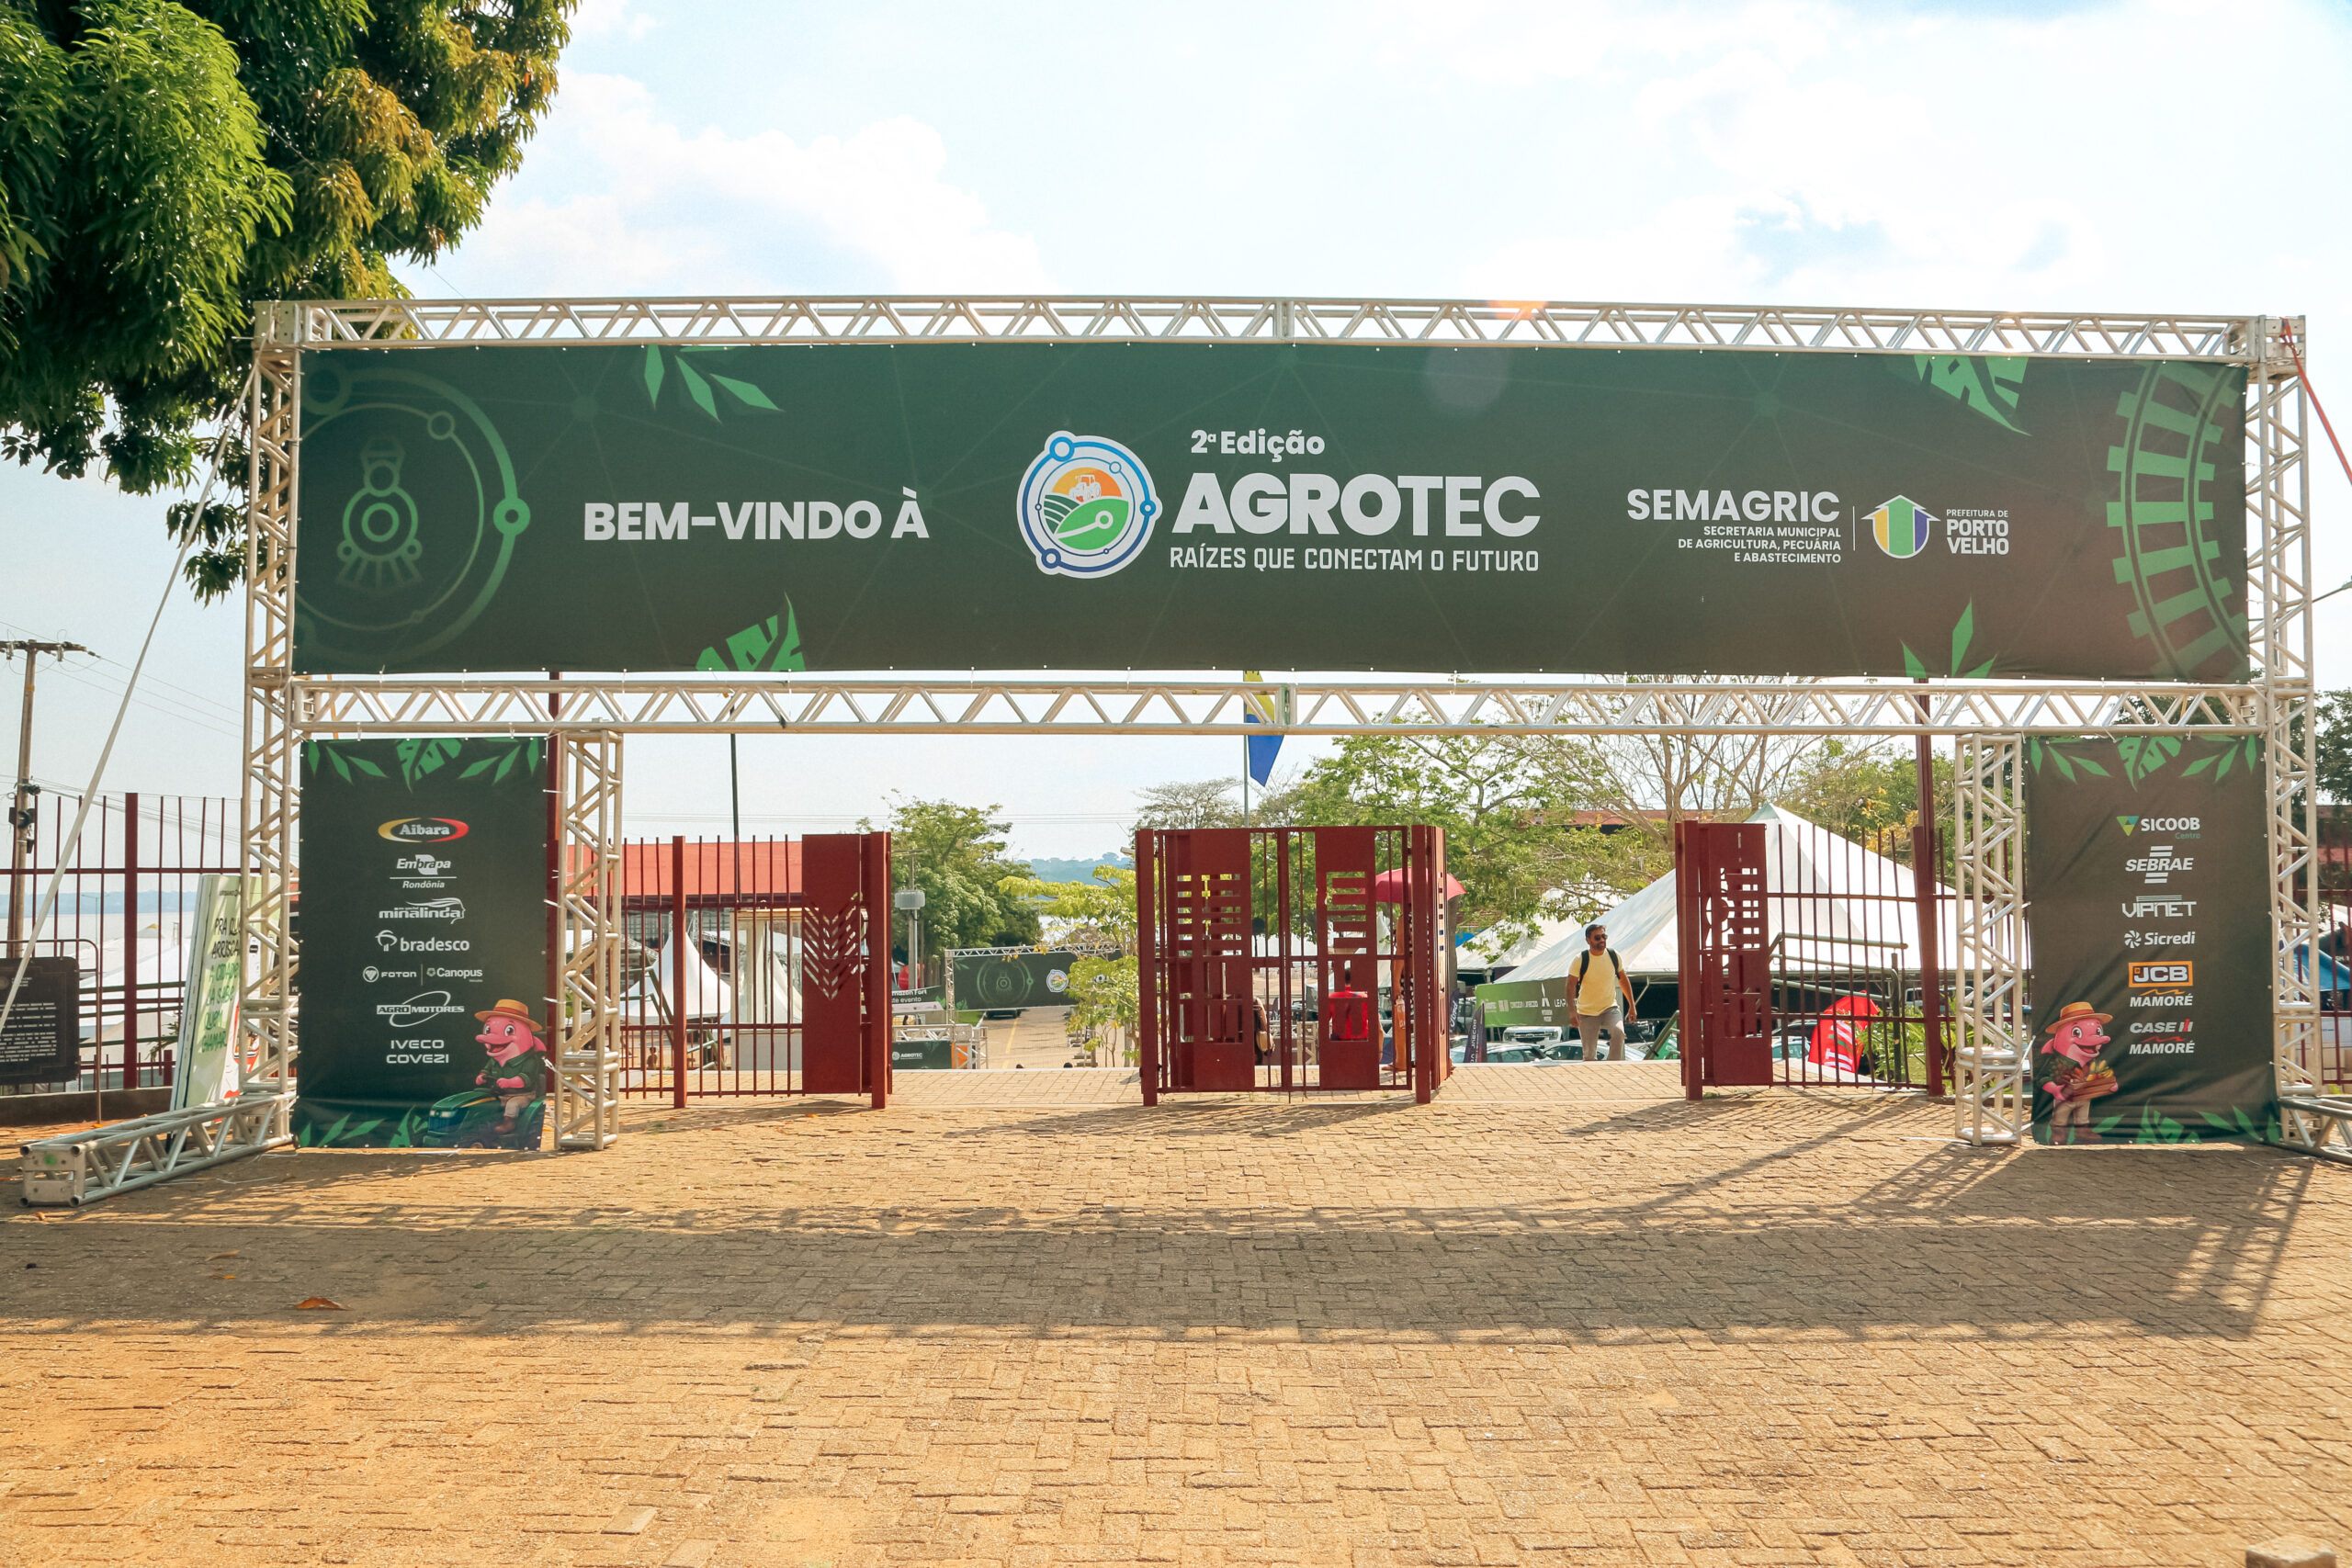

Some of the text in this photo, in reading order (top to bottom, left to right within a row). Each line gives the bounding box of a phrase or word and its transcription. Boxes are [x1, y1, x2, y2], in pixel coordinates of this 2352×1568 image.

[1220, 428, 1326, 463] Edição
[1171, 472, 1542, 537] AGROTEC
[1627, 489, 1840, 523] SEMAGRIC
[583, 486, 930, 541] BEM-VINDO À
[1946, 509, 2009, 518] PREFEITURA DE
[1703, 525, 1842, 537] SECRETARIA MUNICIPAL
[1946, 518, 2009, 536] PORTO
[1678, 538, 1841, 551] DE AGRICULTURA, PECUÁRIA
[1946, 536, 2009, 556] VELHO
[1170, 543, 1540, 572] RAÍZES QUE CONECTAM O FUTURO
[1734, 552, 1841, 563] E ABASTECIMENTO
[399, 824, 450, 836] Aibara
[2140, 817, 2201, 832] SICOOB
[396, 857, 452, 873] Embrapa
[2125, 857, 2195, 872] SEBRAE
[401, 880, 446, 889] Rondônia
[379, 907, 461, 919] minalinda
[400, 936, 470, 952] bradesco
[2143, 931, 2196, 946] Sicredi
[436, 967, 483, 979] Canopus
[2133, 965, 2188, 983] JCB
[2129, 993, 2194, 1008] MAMORÉ
[2129, 1021, 2177, 1033] CASE
[390, 1039, 445, 1049] IVECO
[2129, 1040, 2195, 1055] MAMORÉ
[386, 1054, 449, 1064] COVEZI
